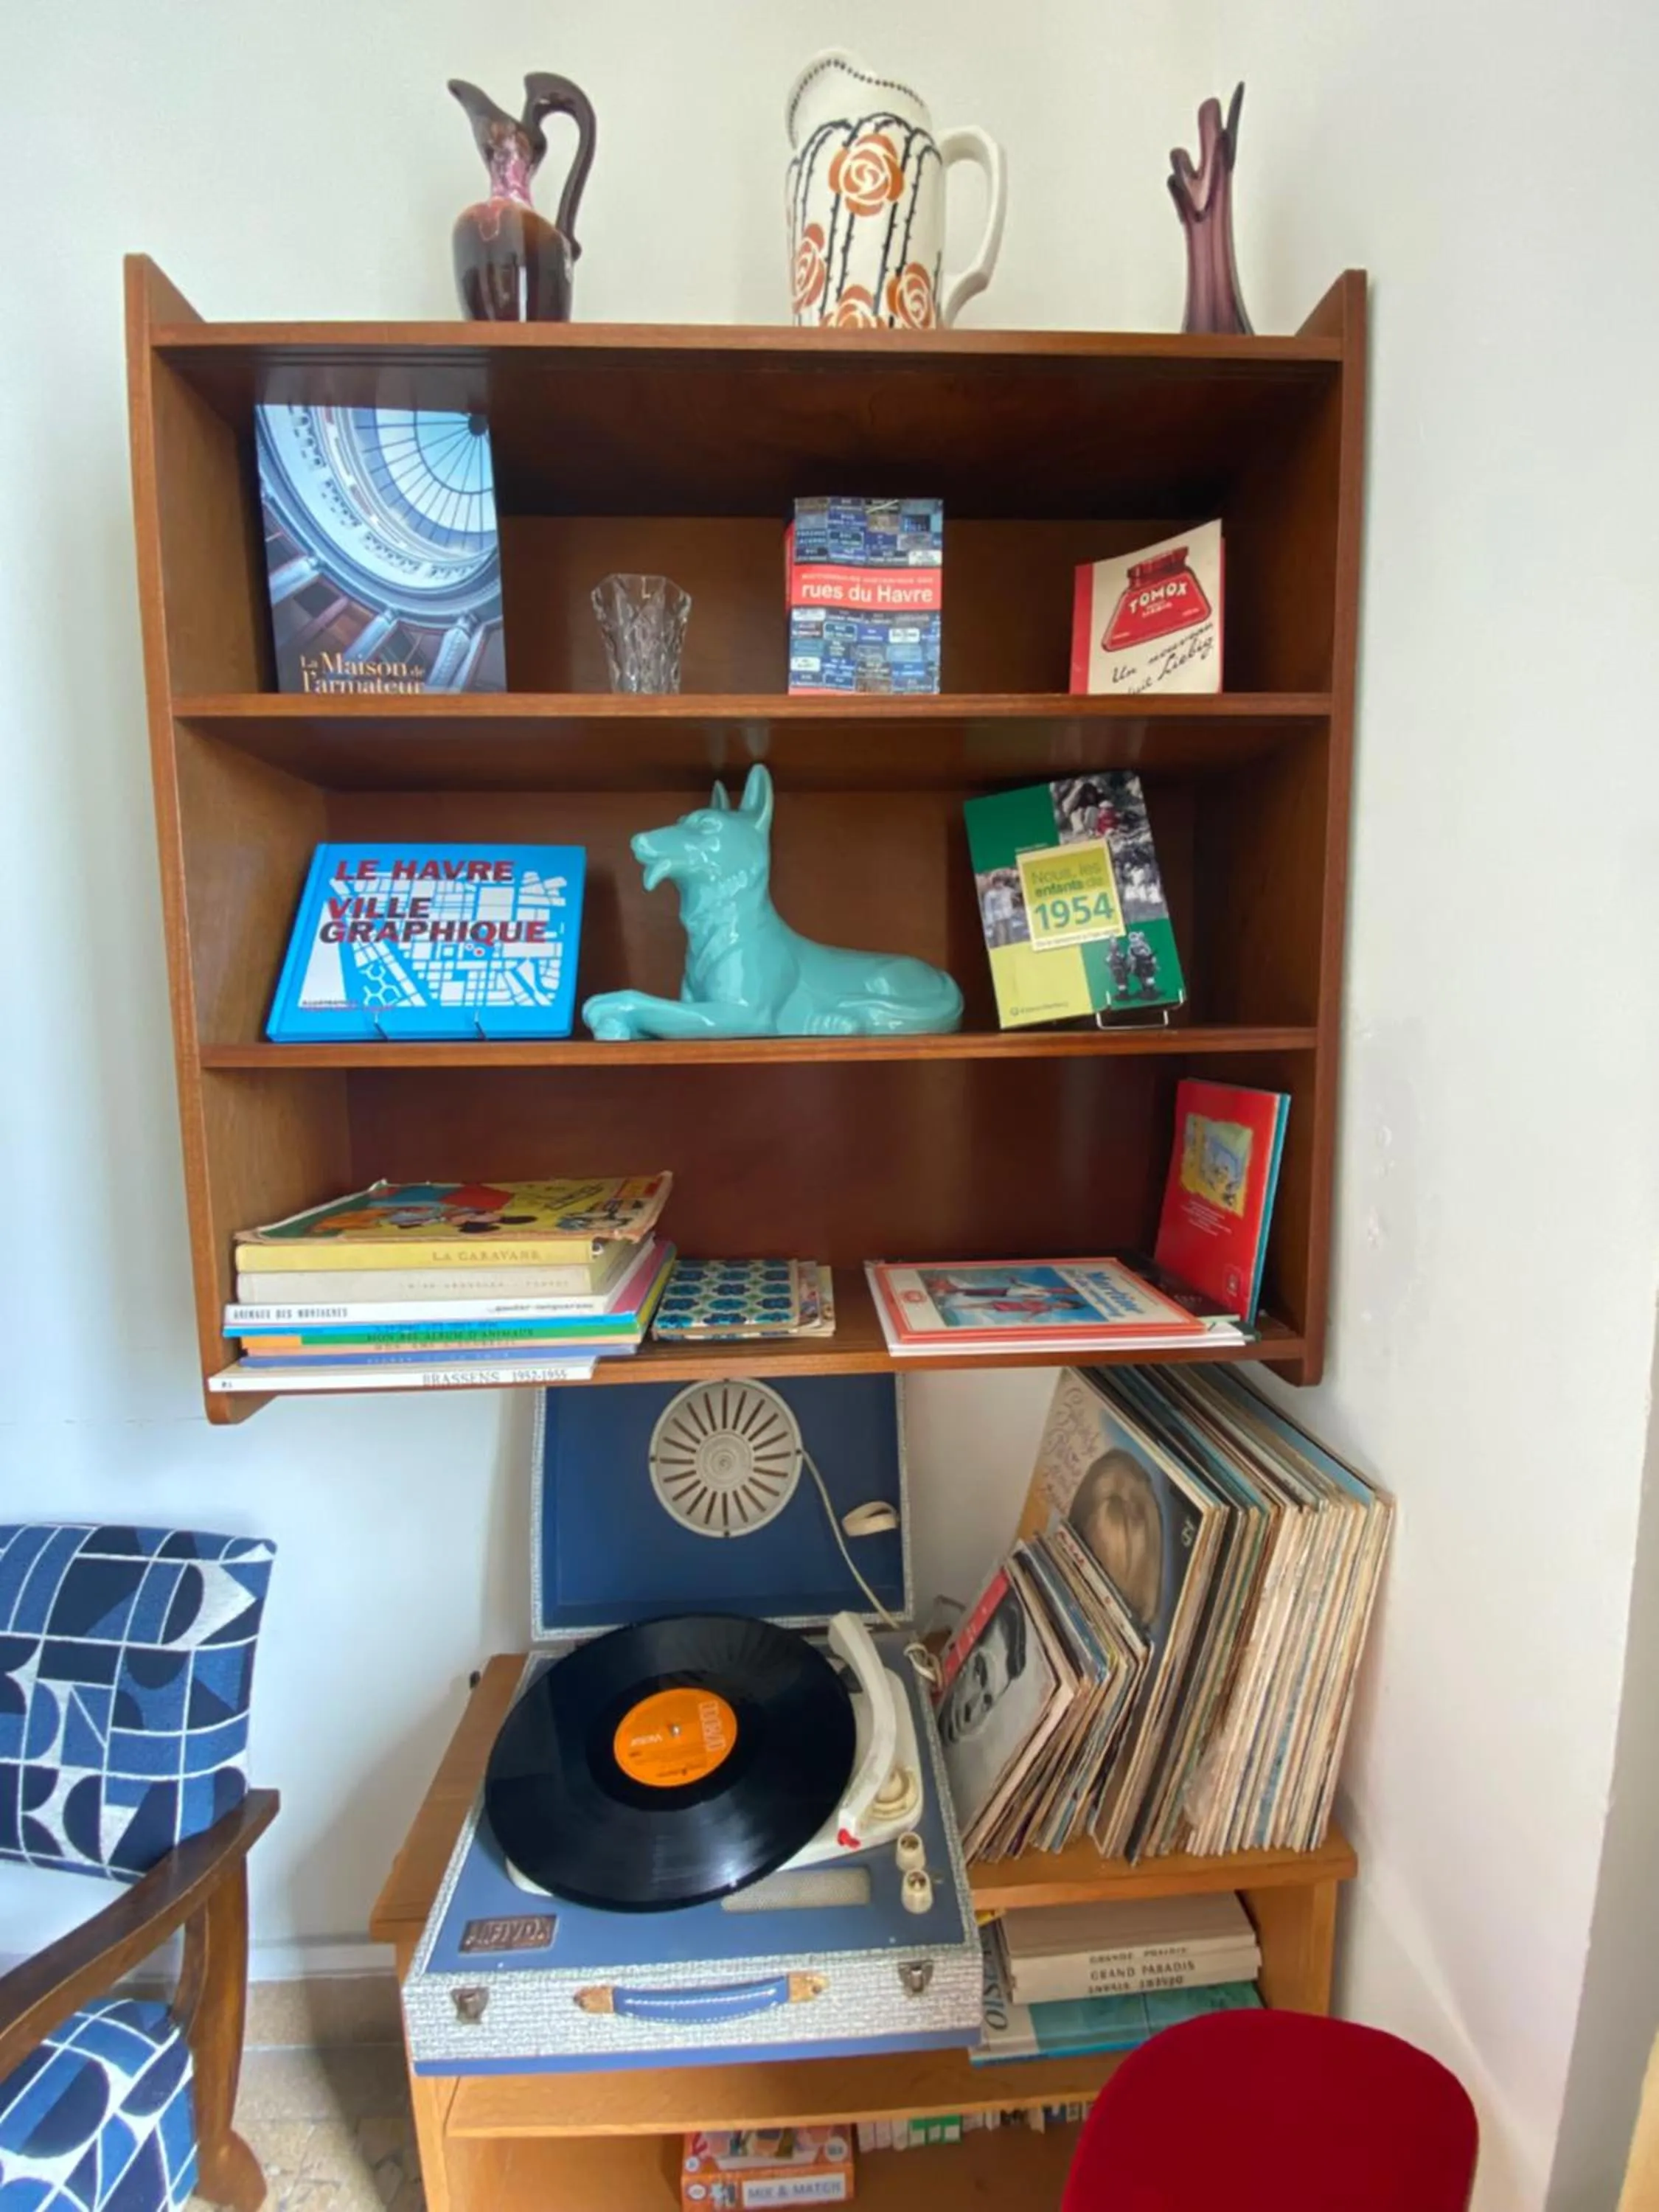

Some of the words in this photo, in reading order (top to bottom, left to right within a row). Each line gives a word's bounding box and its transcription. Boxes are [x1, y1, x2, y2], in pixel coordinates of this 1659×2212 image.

[802, 585, 844, 600] rues
[849, 585, 872, 602] du
[877, 585, 933, 603] Havre
[1130, 582, 1189, 613] TOMOX
[321, 652, 408, 676] Maison
[335, 860, 380, 881] LE
[392, 860, 514, 881] HAVRE
[328, 897, 431, 919] VILLE
[1034, 891, 1113, 930] 1954
[319, 920, 548, 945] GRAPHIQUE
[433, 1251, 453, 1262] LA
[422, 1371, 501, 1385] BRASSENS
[1091, 1966, 1135, 1980] GRAND
[1142, 1960, 1196, 1976] PARADIS
[793, 2182, 841, 2194] MATCH
